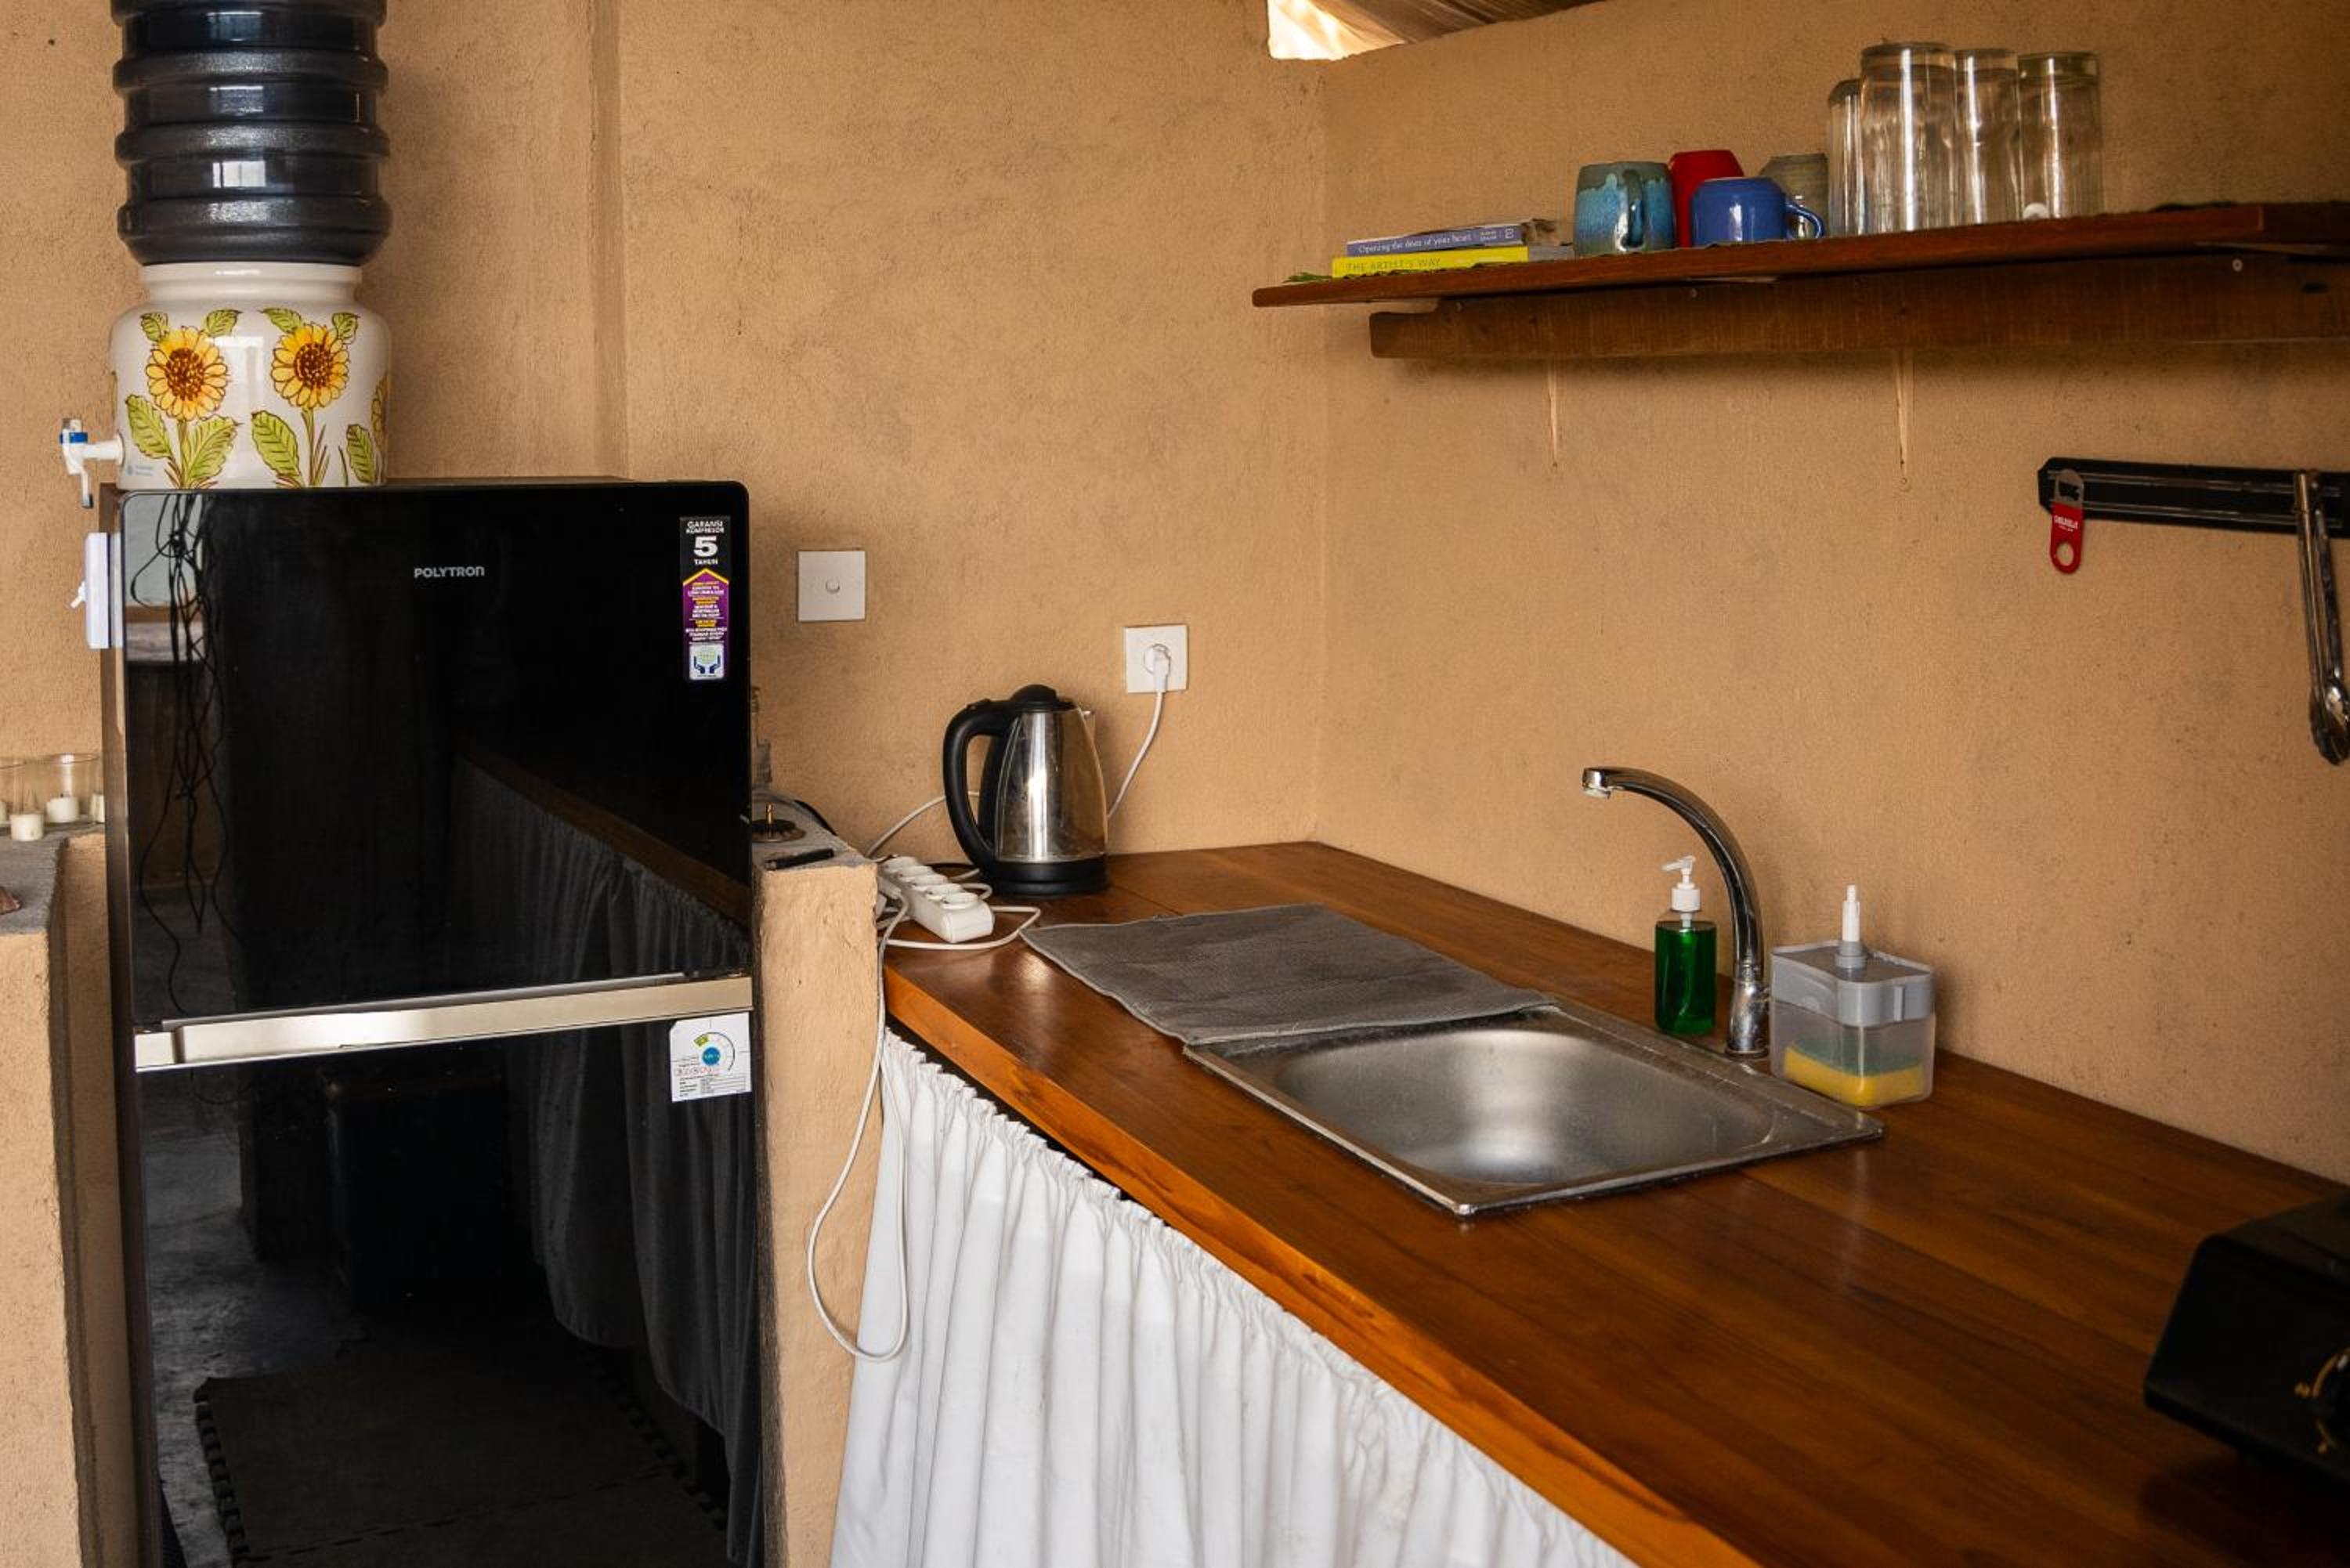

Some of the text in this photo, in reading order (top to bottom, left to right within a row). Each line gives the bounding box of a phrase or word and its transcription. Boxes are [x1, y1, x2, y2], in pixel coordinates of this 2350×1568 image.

[1359, 244, 1390, 254] Opening
[1433, 237, 1451, 247] your
[1347, 262, 1368, 272] THE
[1419, 258, 1441, 268] WAY
[693, 535, 718, 557] 5
[414, 566, 485, 579] POLYTRON
